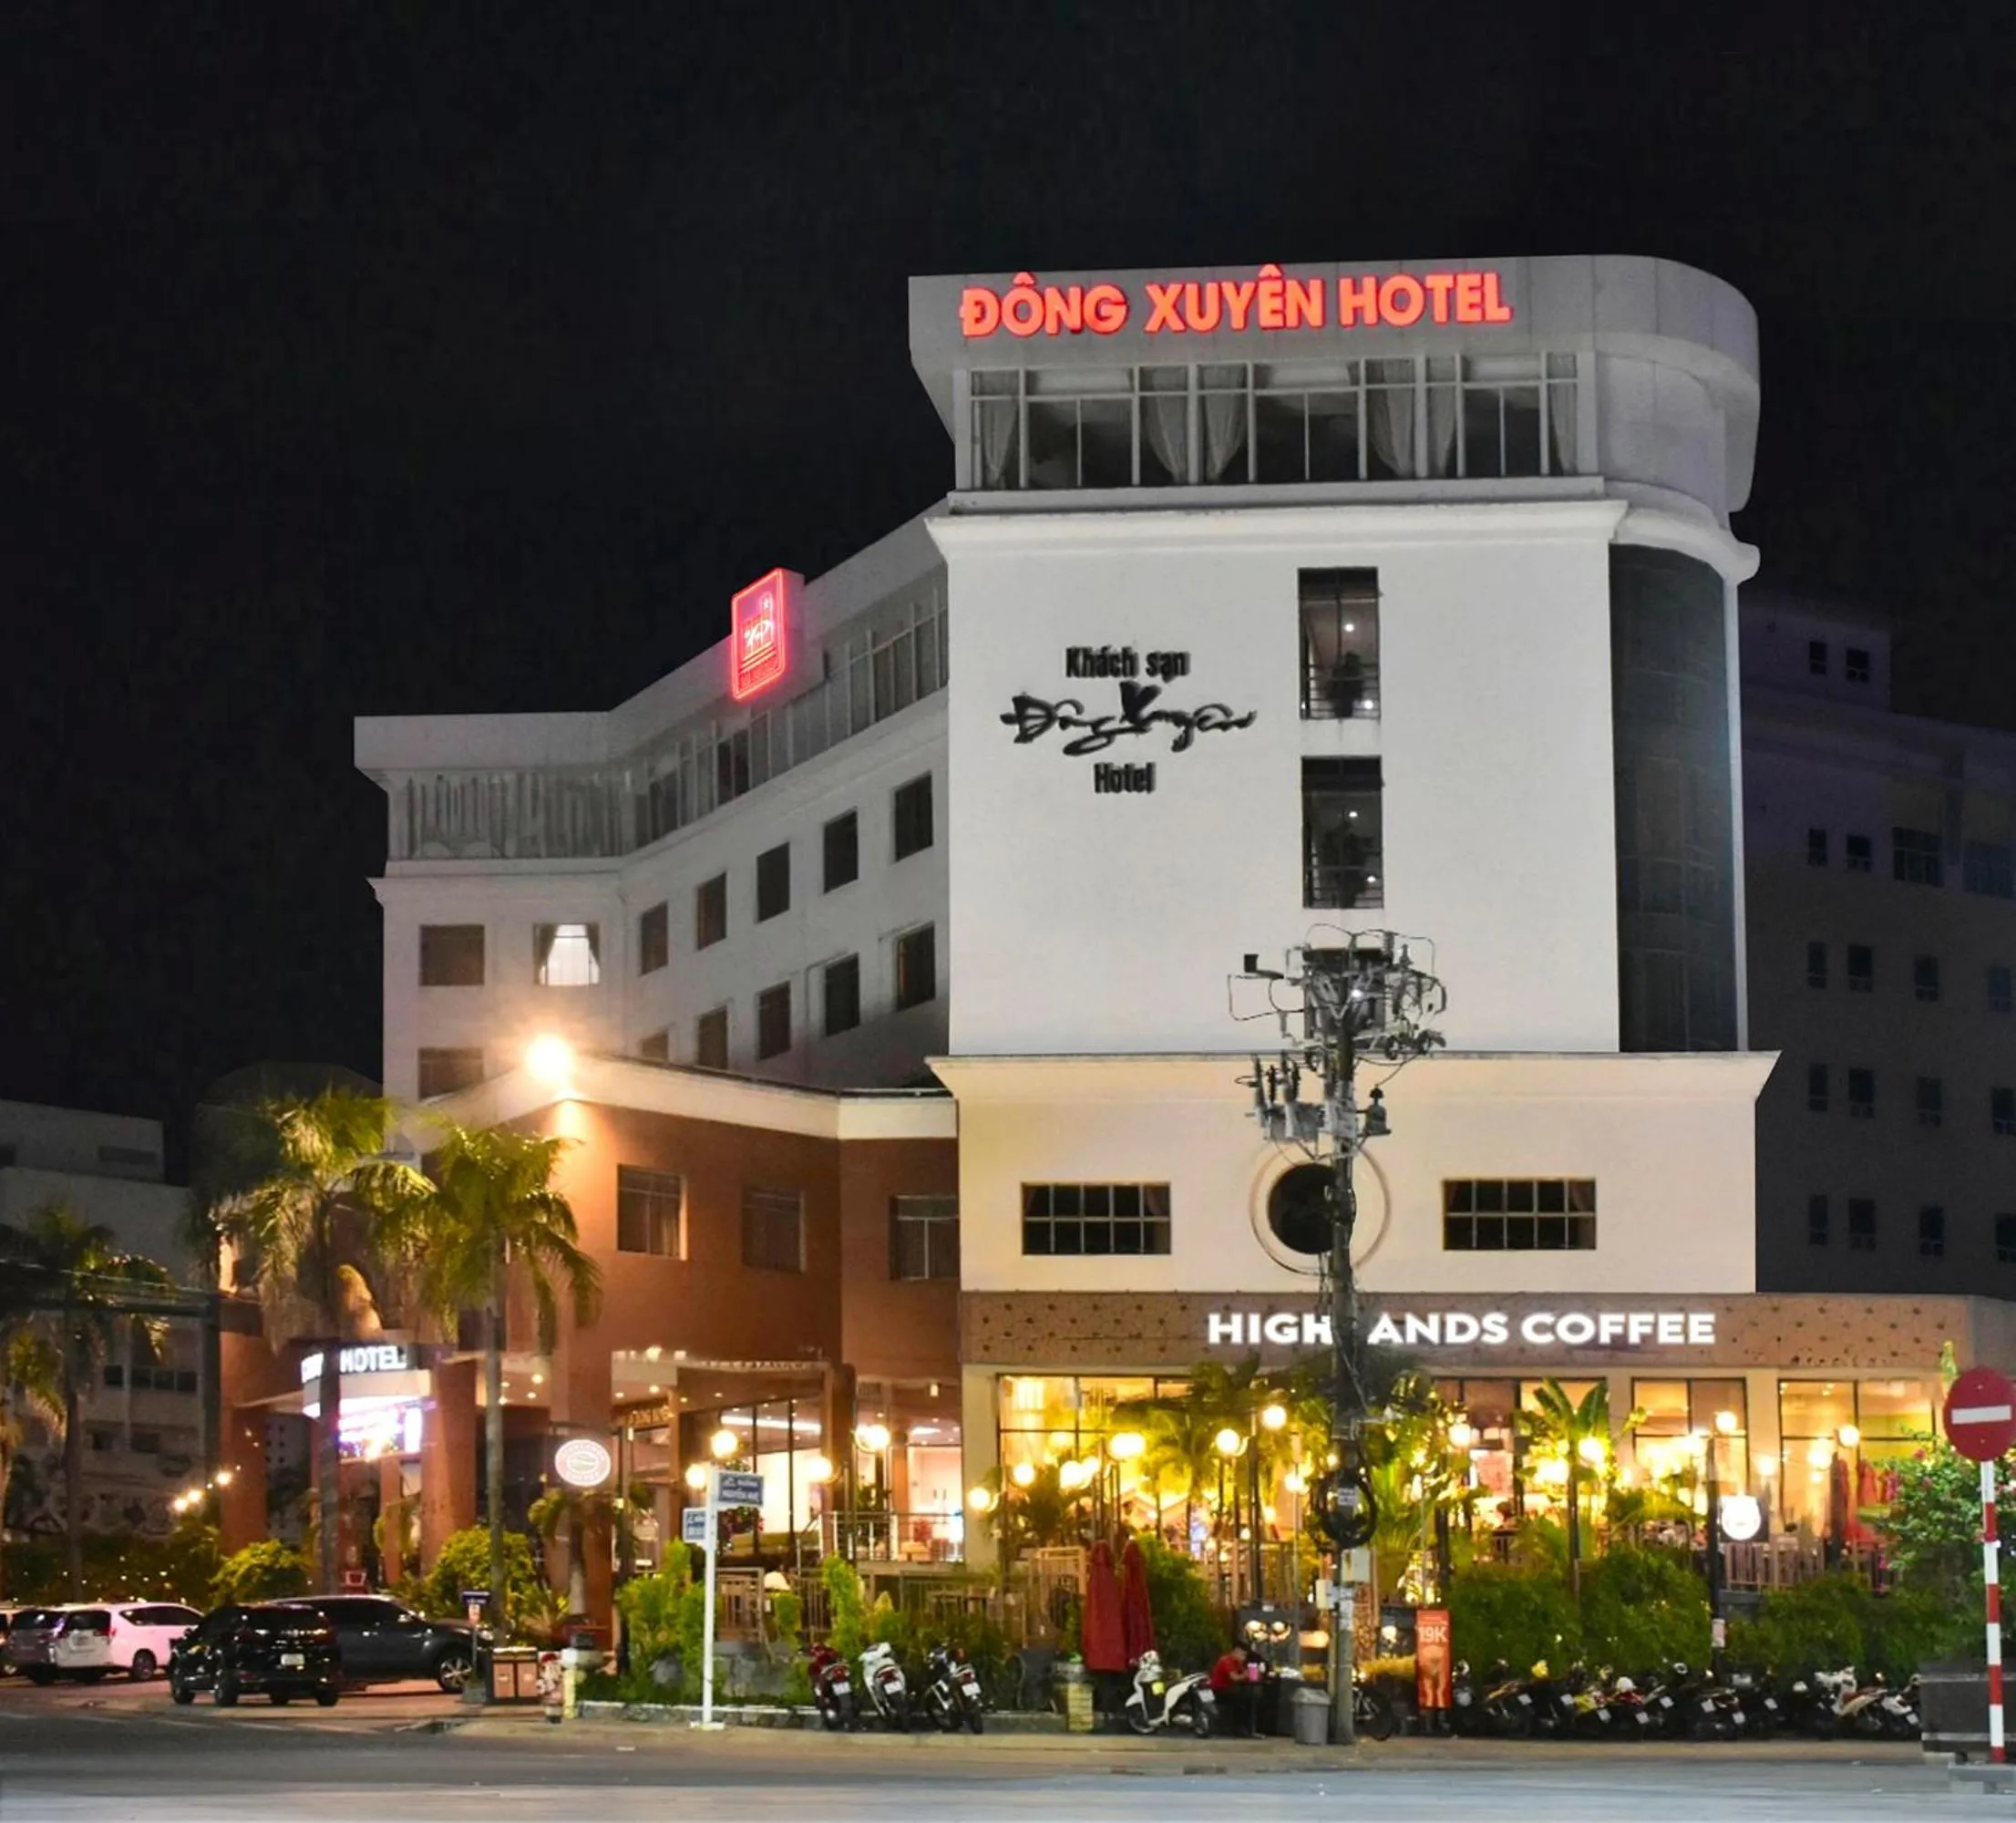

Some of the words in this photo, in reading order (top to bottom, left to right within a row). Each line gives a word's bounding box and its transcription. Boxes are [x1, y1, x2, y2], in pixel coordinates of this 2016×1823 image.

[961, 273, 1127, 337] ĐÔNG
[1146, 265, 1325, 334] XUYÊN
[1340, 273, 1510, 328] HOTEL
[1065, 645, 1138, 678] Khách
[1094, 762, 1156, 794] Hotel
[1209, 1313, 1508, 1344] HIGHANDS
[1521, 1313, 1715, 1344] COFFEE
[339, 1344, 407, 1373] HOTEL
